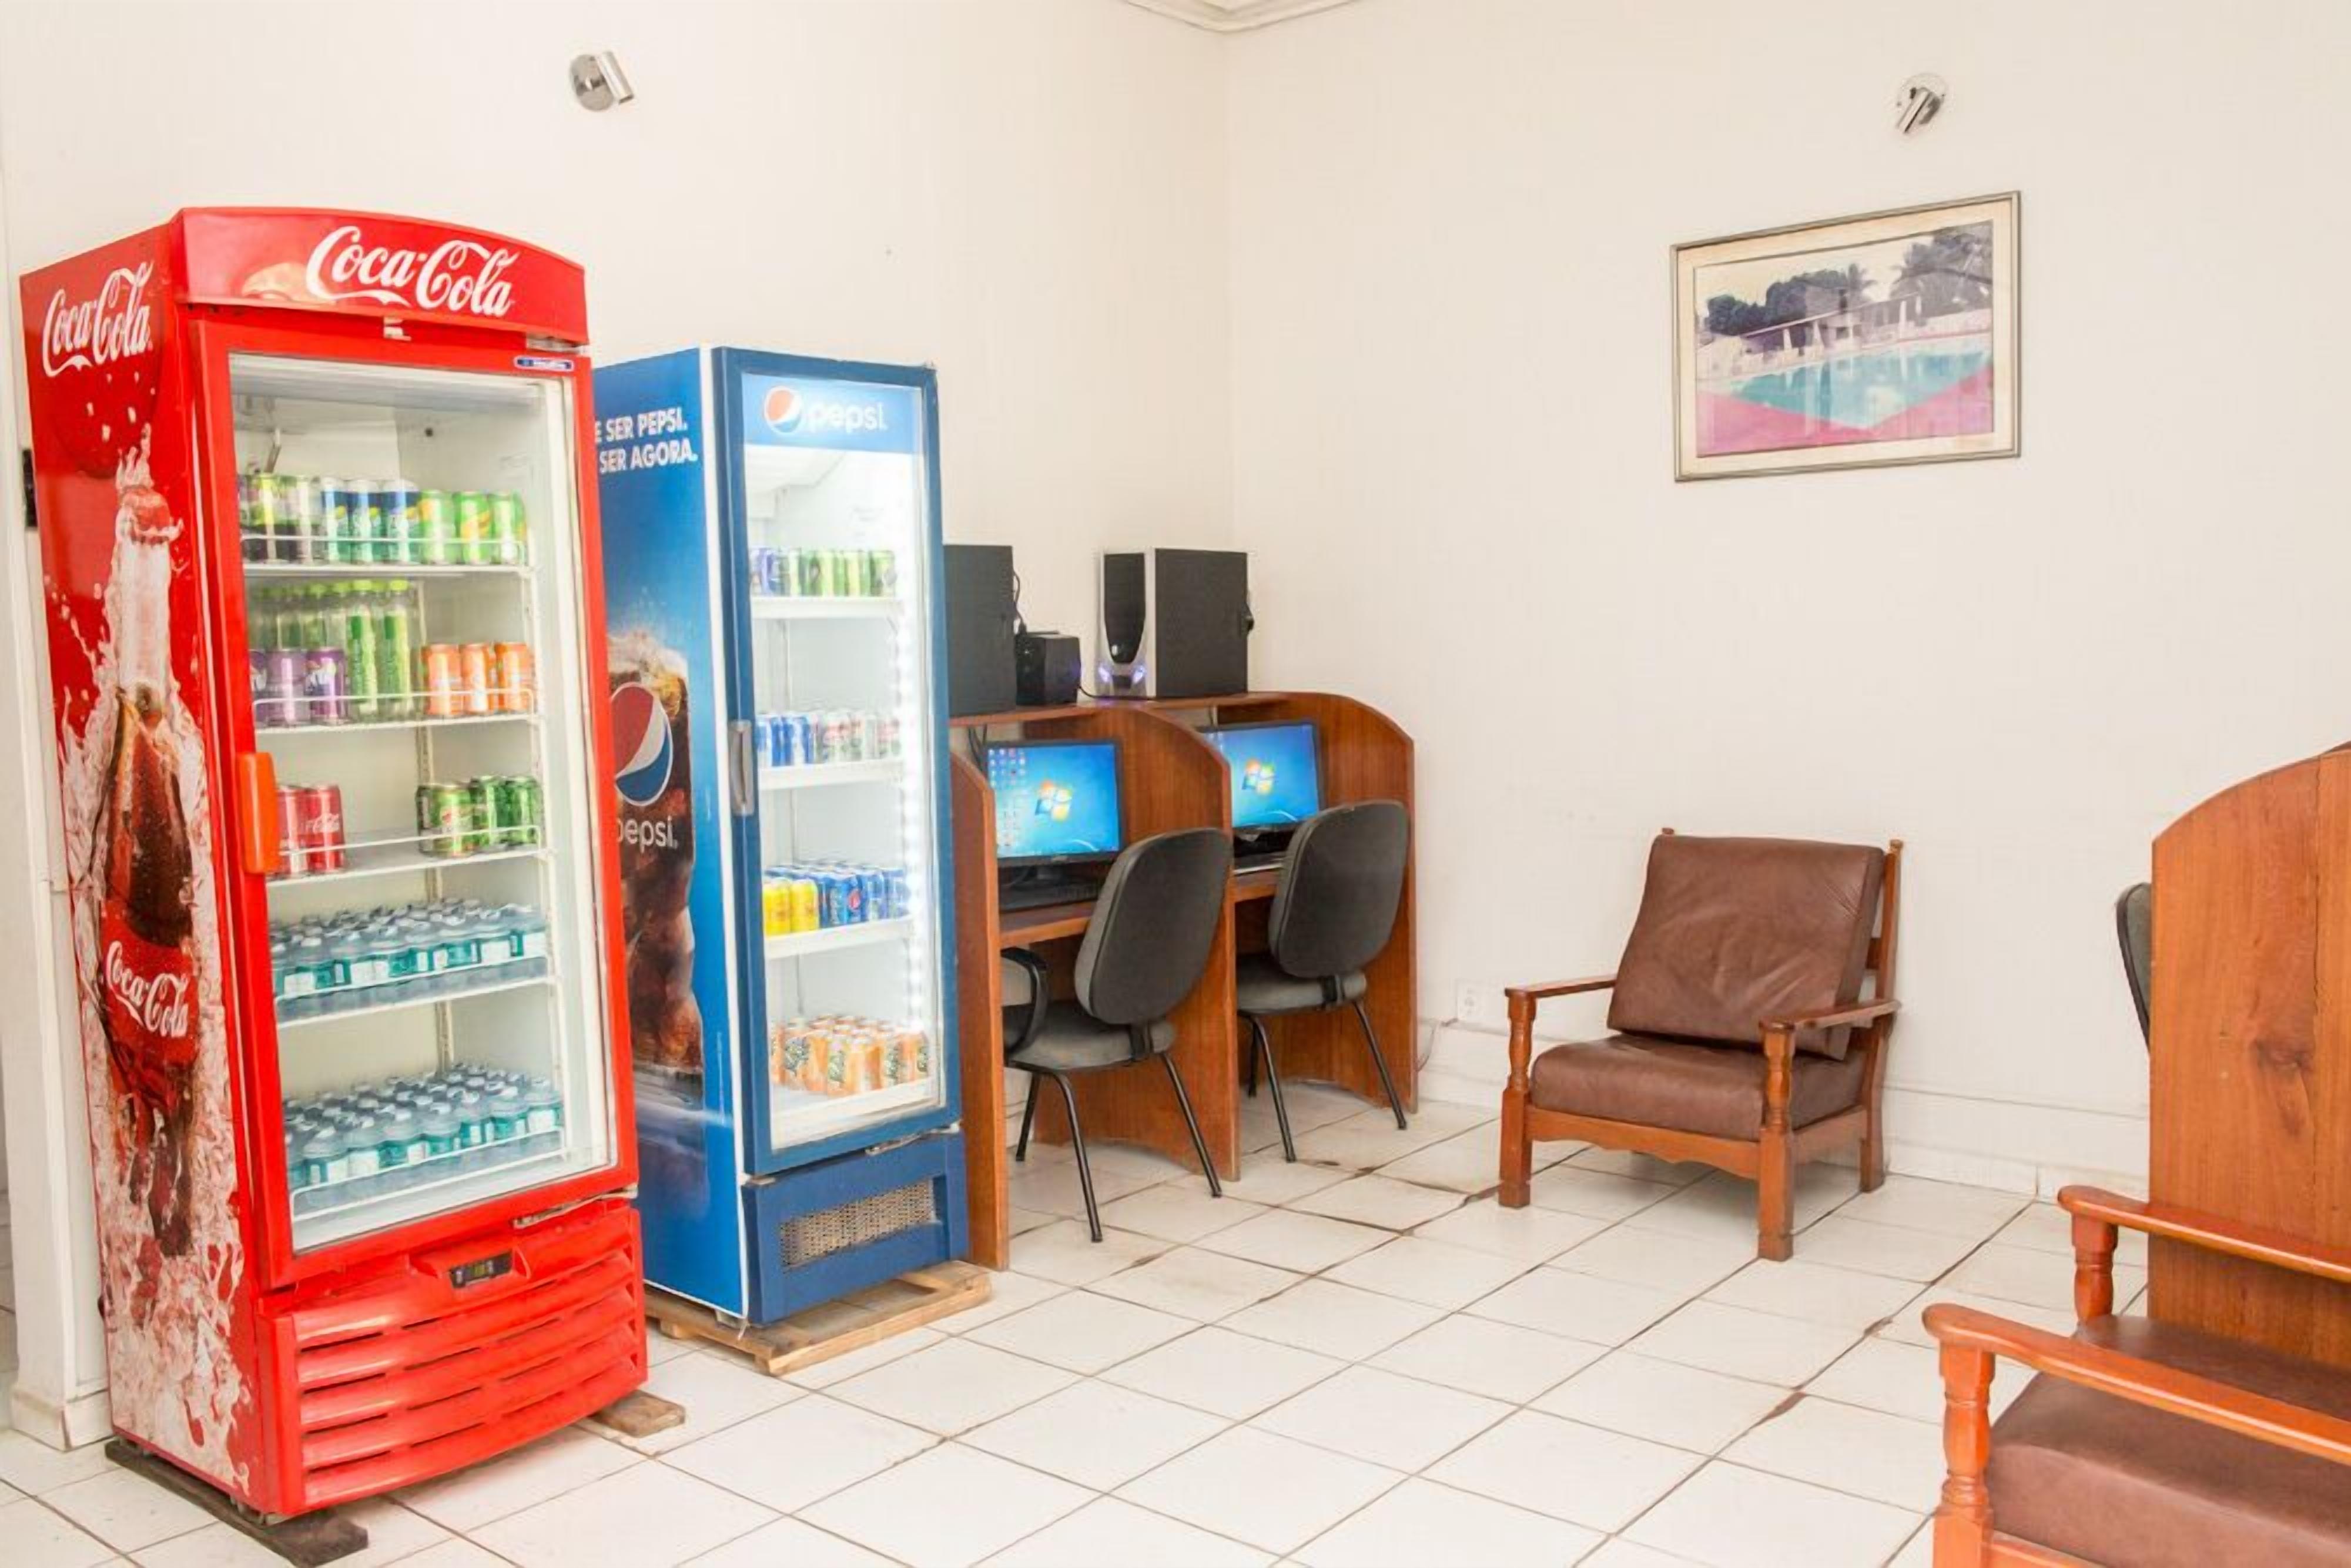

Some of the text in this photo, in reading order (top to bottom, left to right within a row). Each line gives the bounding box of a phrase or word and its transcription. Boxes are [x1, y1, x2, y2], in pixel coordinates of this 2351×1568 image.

[306, 225, 520, 317] Coca-Cola
[42, 259, 155, 377] Coca-Cola
[605, 416, 634, 443] SER
[637, 406, 688, 438] PEPSI.
[808, 401, 885, 435] pepsi
[599, 437, 698, 474] SER AGORA.
[103, 940, 189, 1038] Coca-Cola
